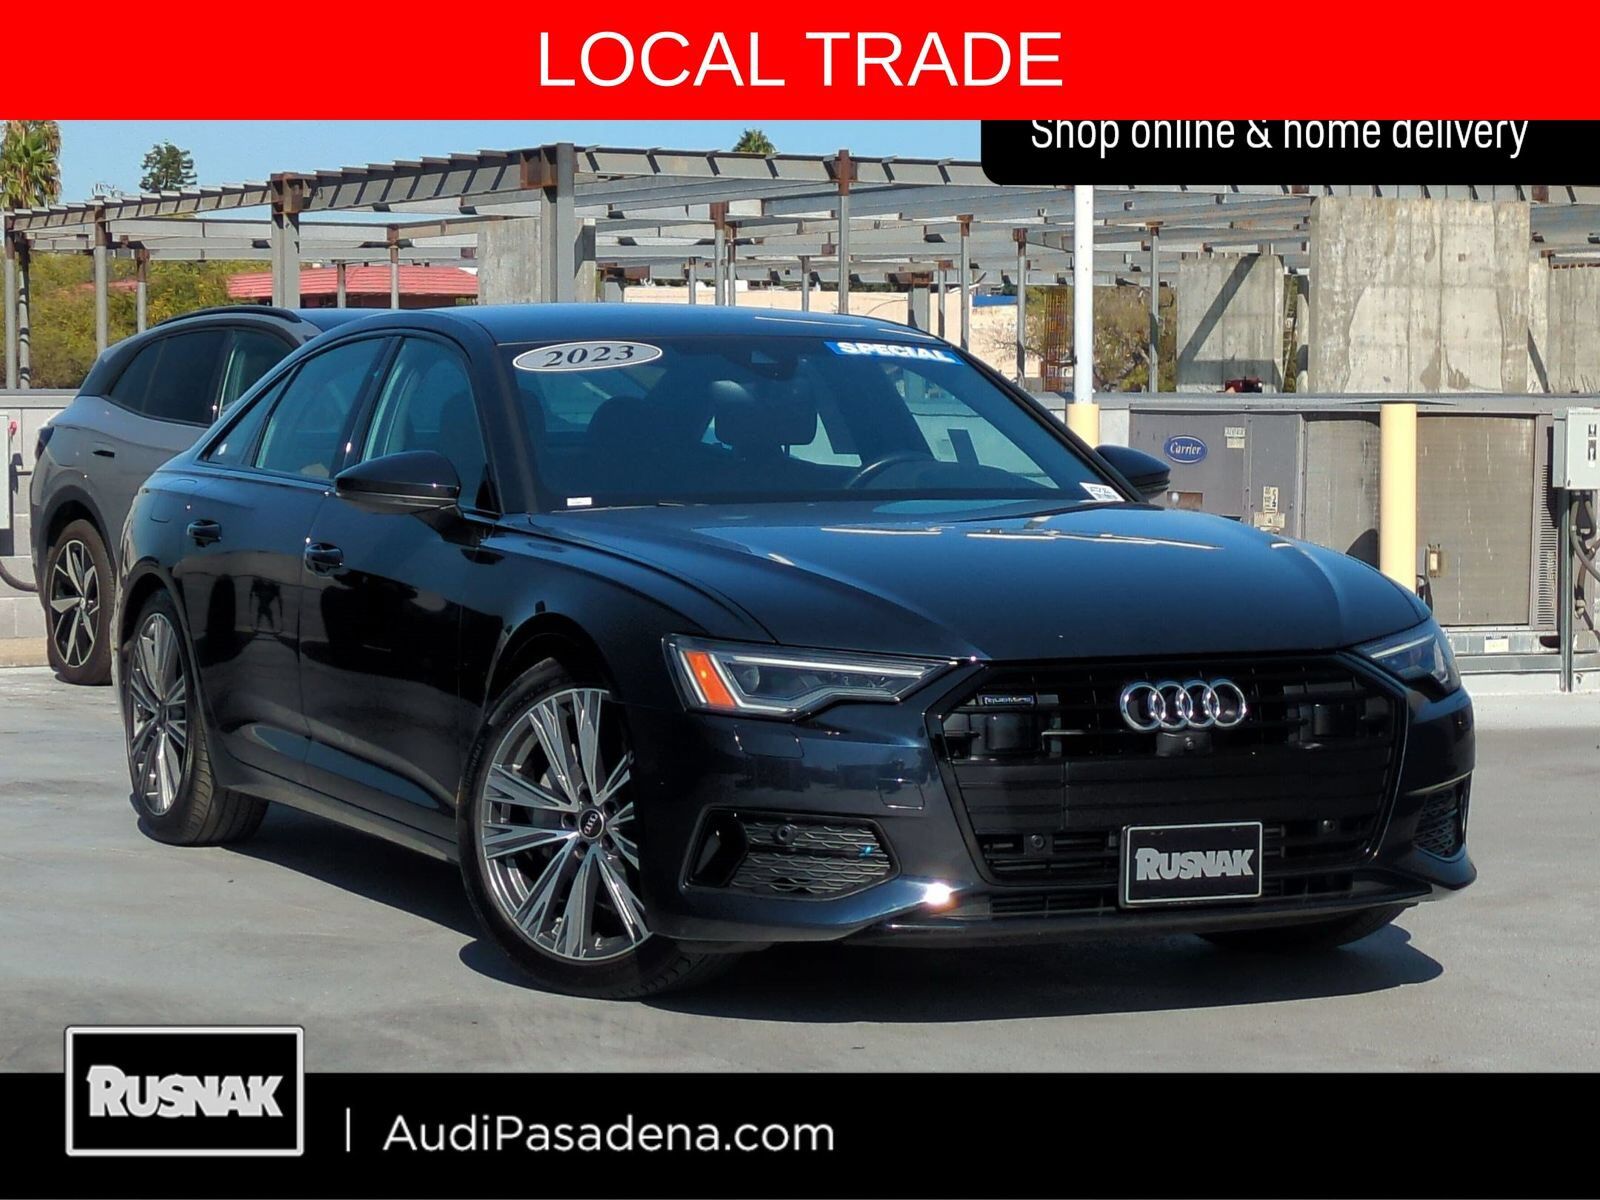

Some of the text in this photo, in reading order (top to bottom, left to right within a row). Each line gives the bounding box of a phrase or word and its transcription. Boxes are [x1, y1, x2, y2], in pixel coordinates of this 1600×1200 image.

[542, 345, 635, 368] 2023
[836, 341, 957, 364] SPECIAL
[1170, 441, 1202, 455] Carrier
[1135, 847, 1255, 881] RUSNAK
